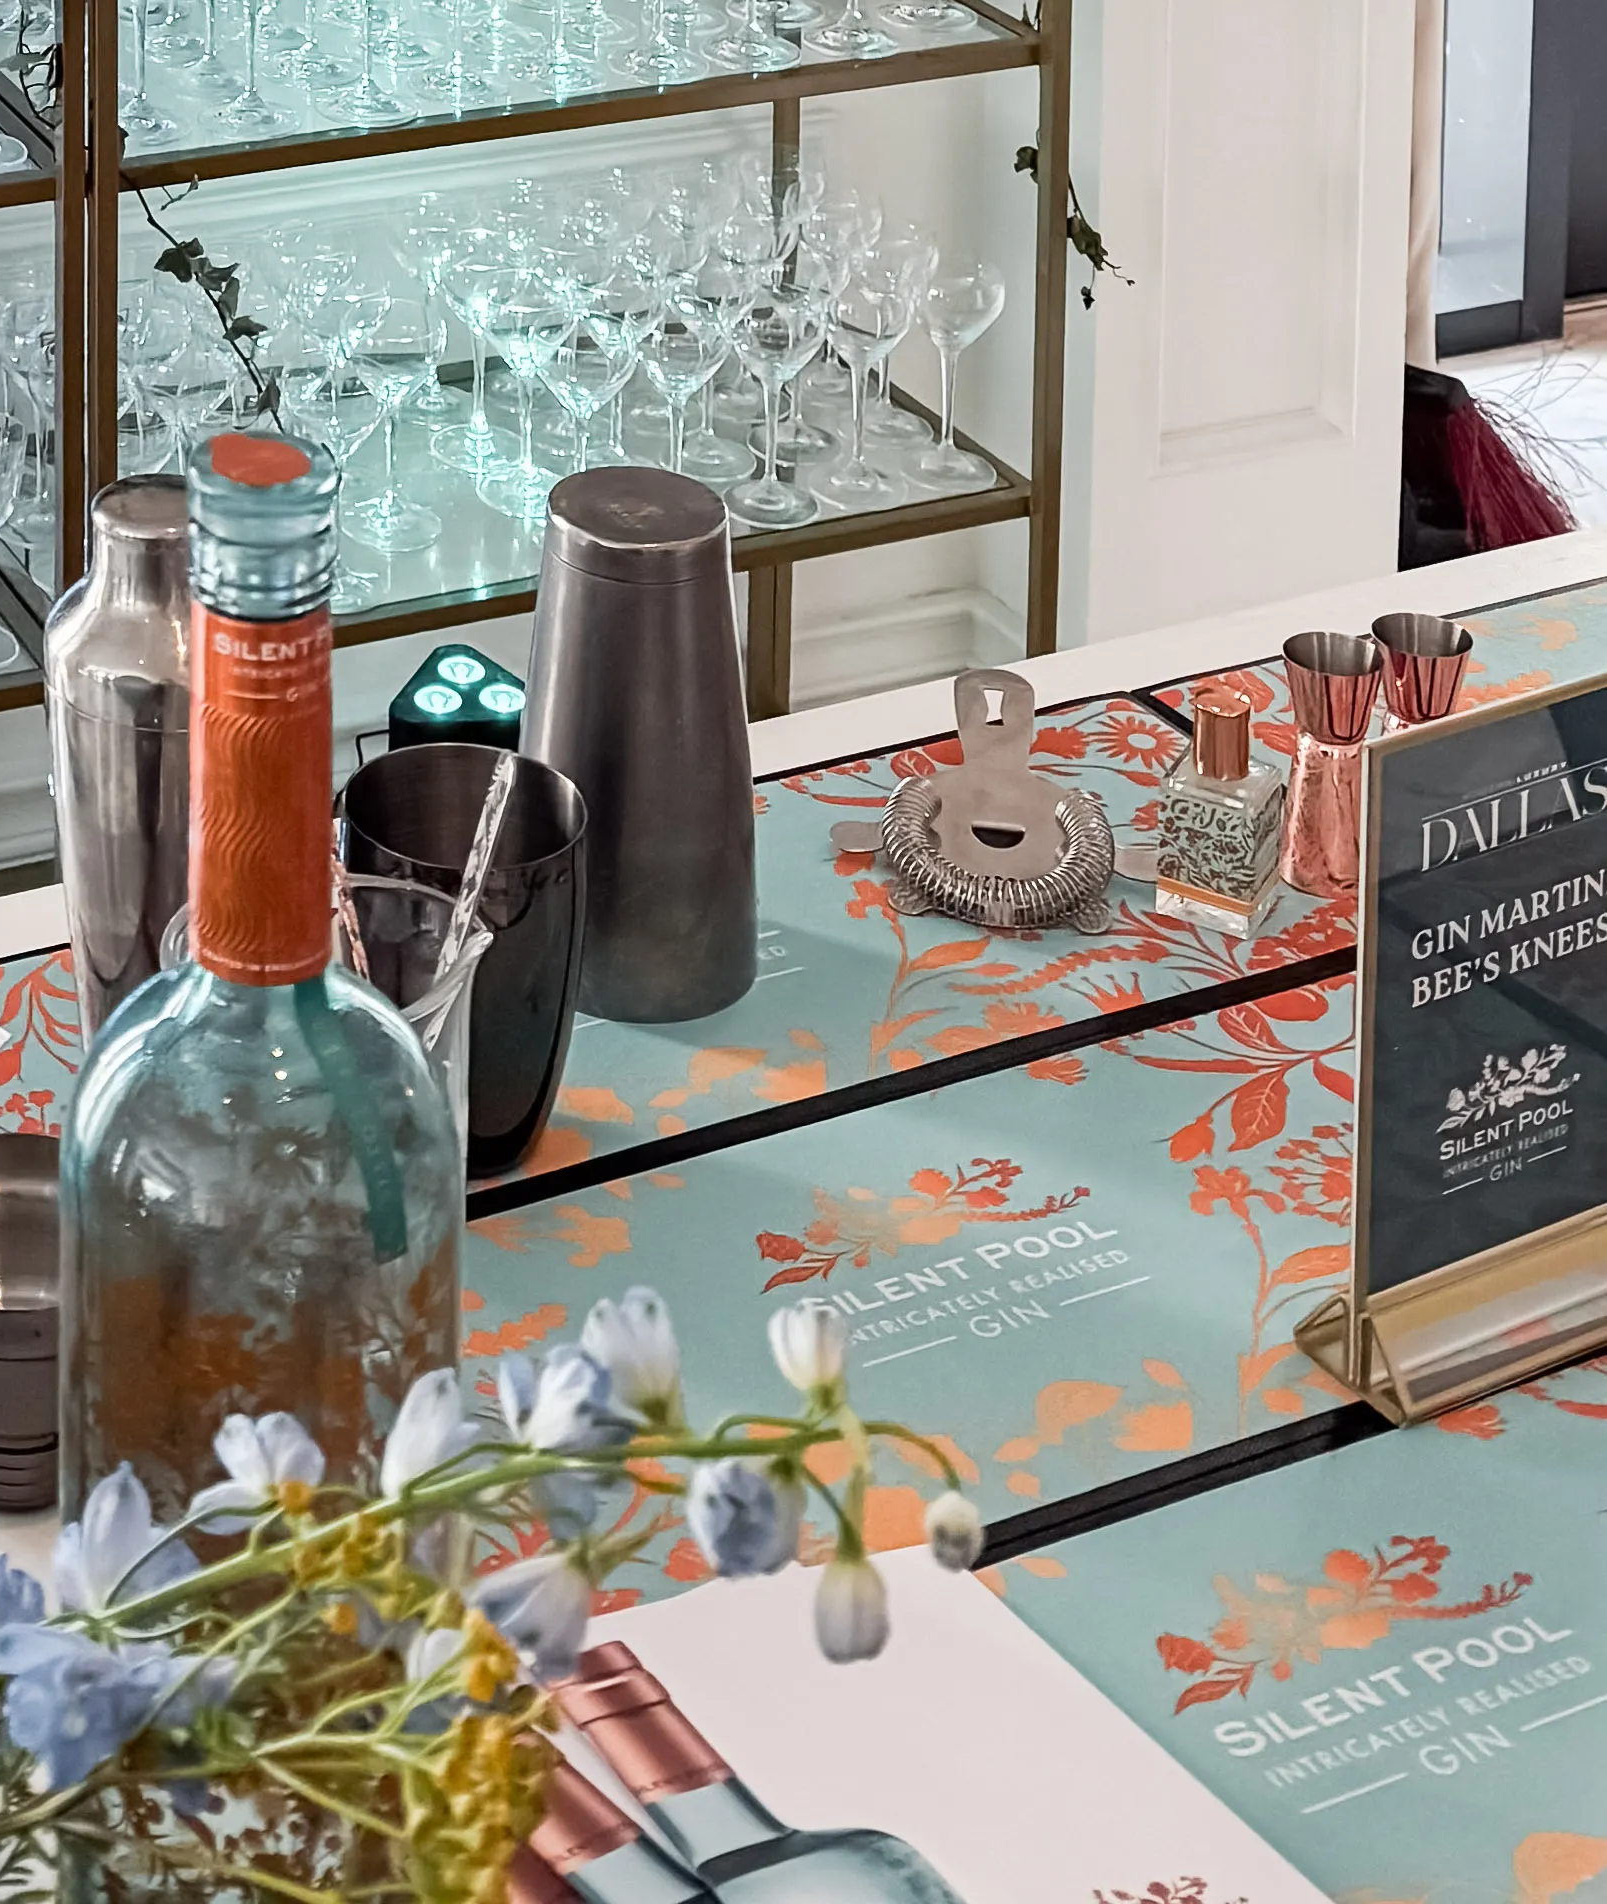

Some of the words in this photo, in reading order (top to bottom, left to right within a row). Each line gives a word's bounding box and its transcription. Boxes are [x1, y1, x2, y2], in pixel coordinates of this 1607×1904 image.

[213, 632, 314, 661] SILENT
[1411, 915, 1471, 960] GIN
[1479, 869, 1607, 939] MARTIN
[1411, 951, 1500, 1008] BEE'S
[1509, 912, 1607, 974] KNEES
[1440, 1119, 1515, 1160] SILENT
[1518, 1099, 1574, 1132] POOL
[1490, 1156, 1523, 1181] GIN
[972, 1221, 1118, 1270] POOL
[850, 1287, 1000, 1346] NTRICATELY
[1007, 1248, 1131, 1294] REALISED
[968, 1299, 1051, 1339] GIN
[1214, 1665, 1412, 1757] SILENT
[1412, 1617, 1574, 1683] POOL
[1264, 1706, 1452, 1788] INTRICATELY
[1456, 1656, 1592, 1716] REALISED
[1418, 1724, 1515, 1776] GIN
